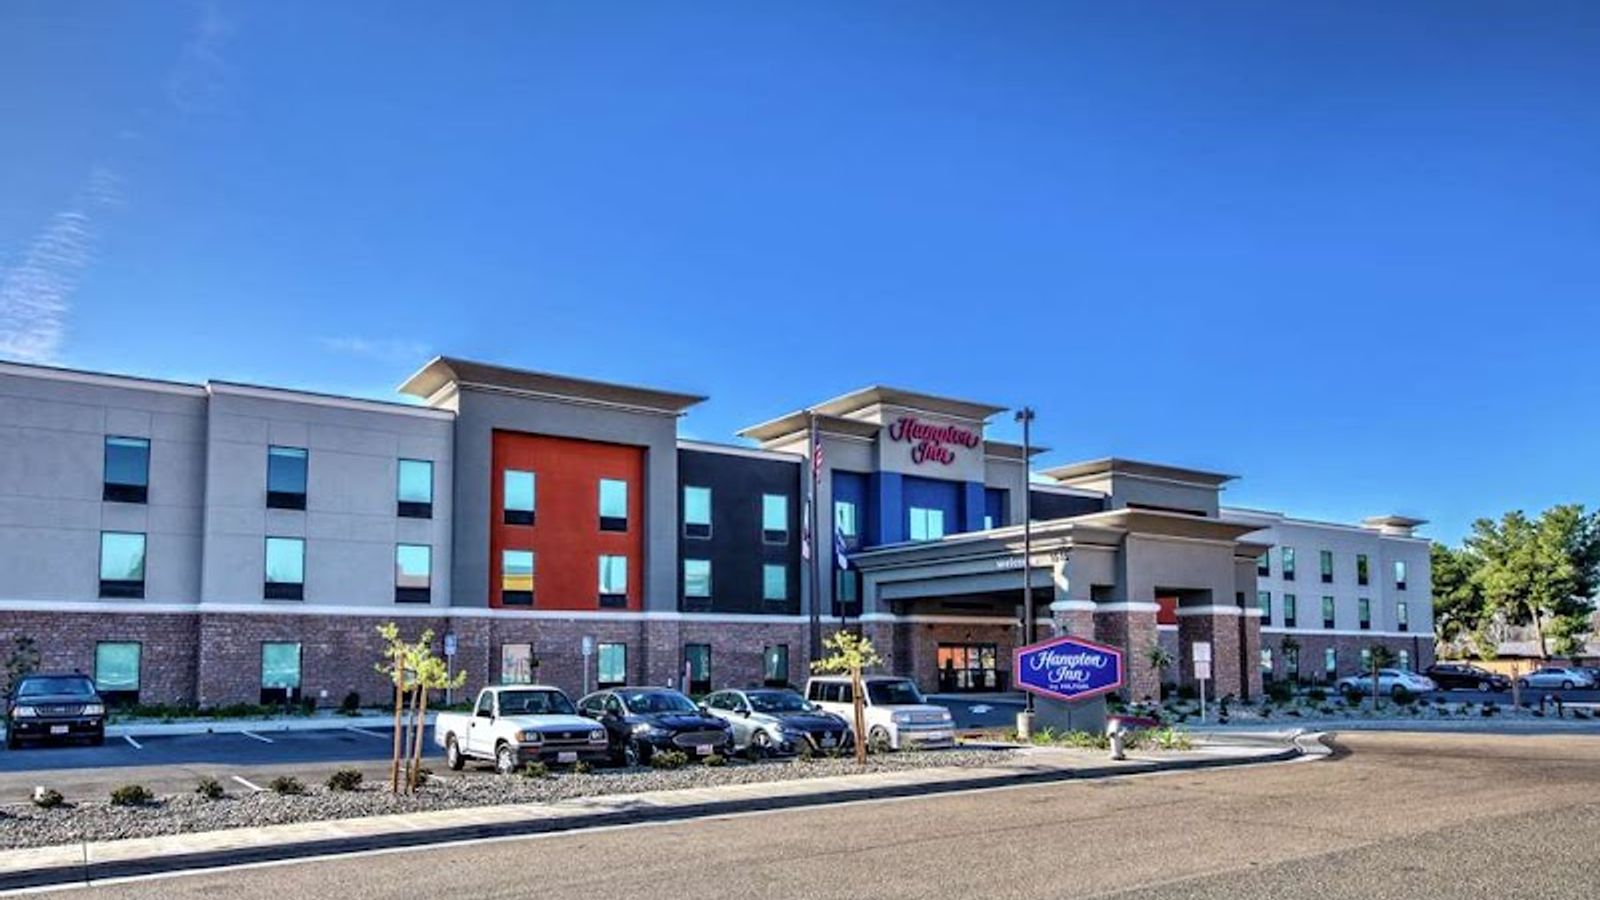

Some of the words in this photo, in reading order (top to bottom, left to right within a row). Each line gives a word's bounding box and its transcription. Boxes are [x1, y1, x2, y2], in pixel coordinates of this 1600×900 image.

[888, 416, 979, 449] Hampton
[911, 442, 955, 465] Inn
[1030, 651, 1107, 671] Hampton
[1048, 666, 1090, 683] Inn
